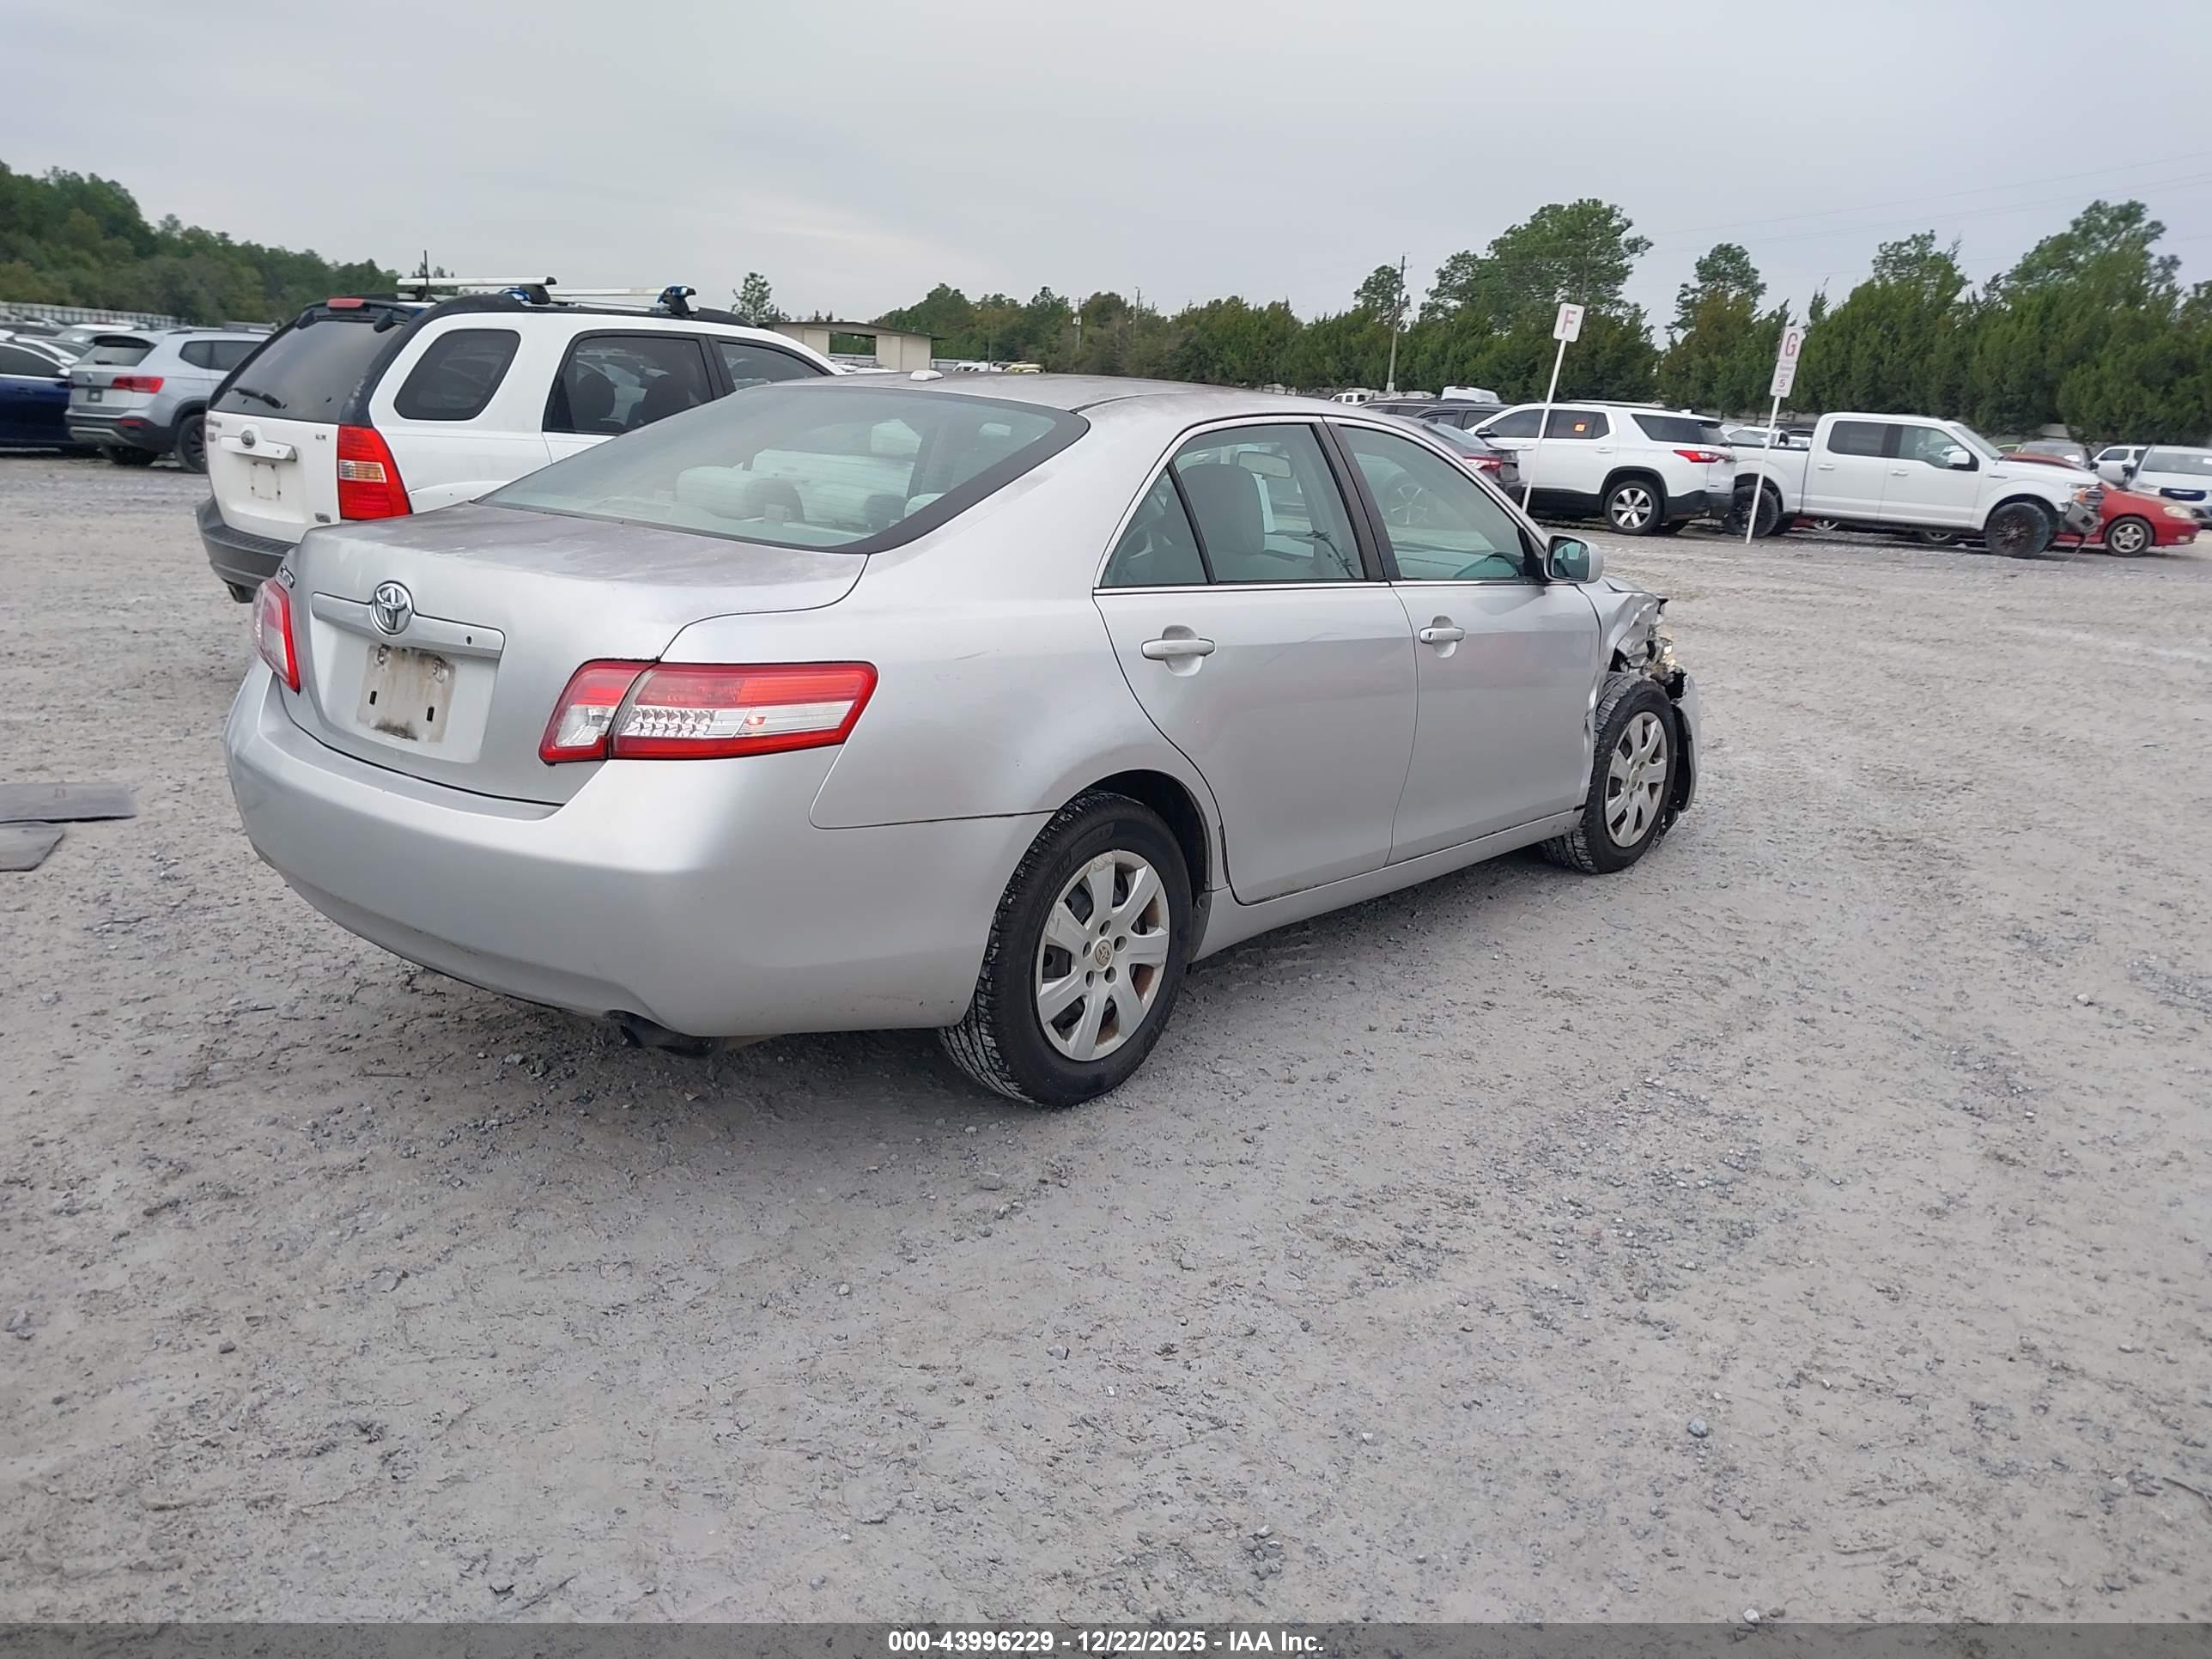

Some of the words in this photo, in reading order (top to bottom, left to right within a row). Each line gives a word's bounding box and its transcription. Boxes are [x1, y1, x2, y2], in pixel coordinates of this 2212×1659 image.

[1561, 309, 1577, 334] F
[1784, 331, 1799, 357] G
[1778, 379, 1786, 387] 5
